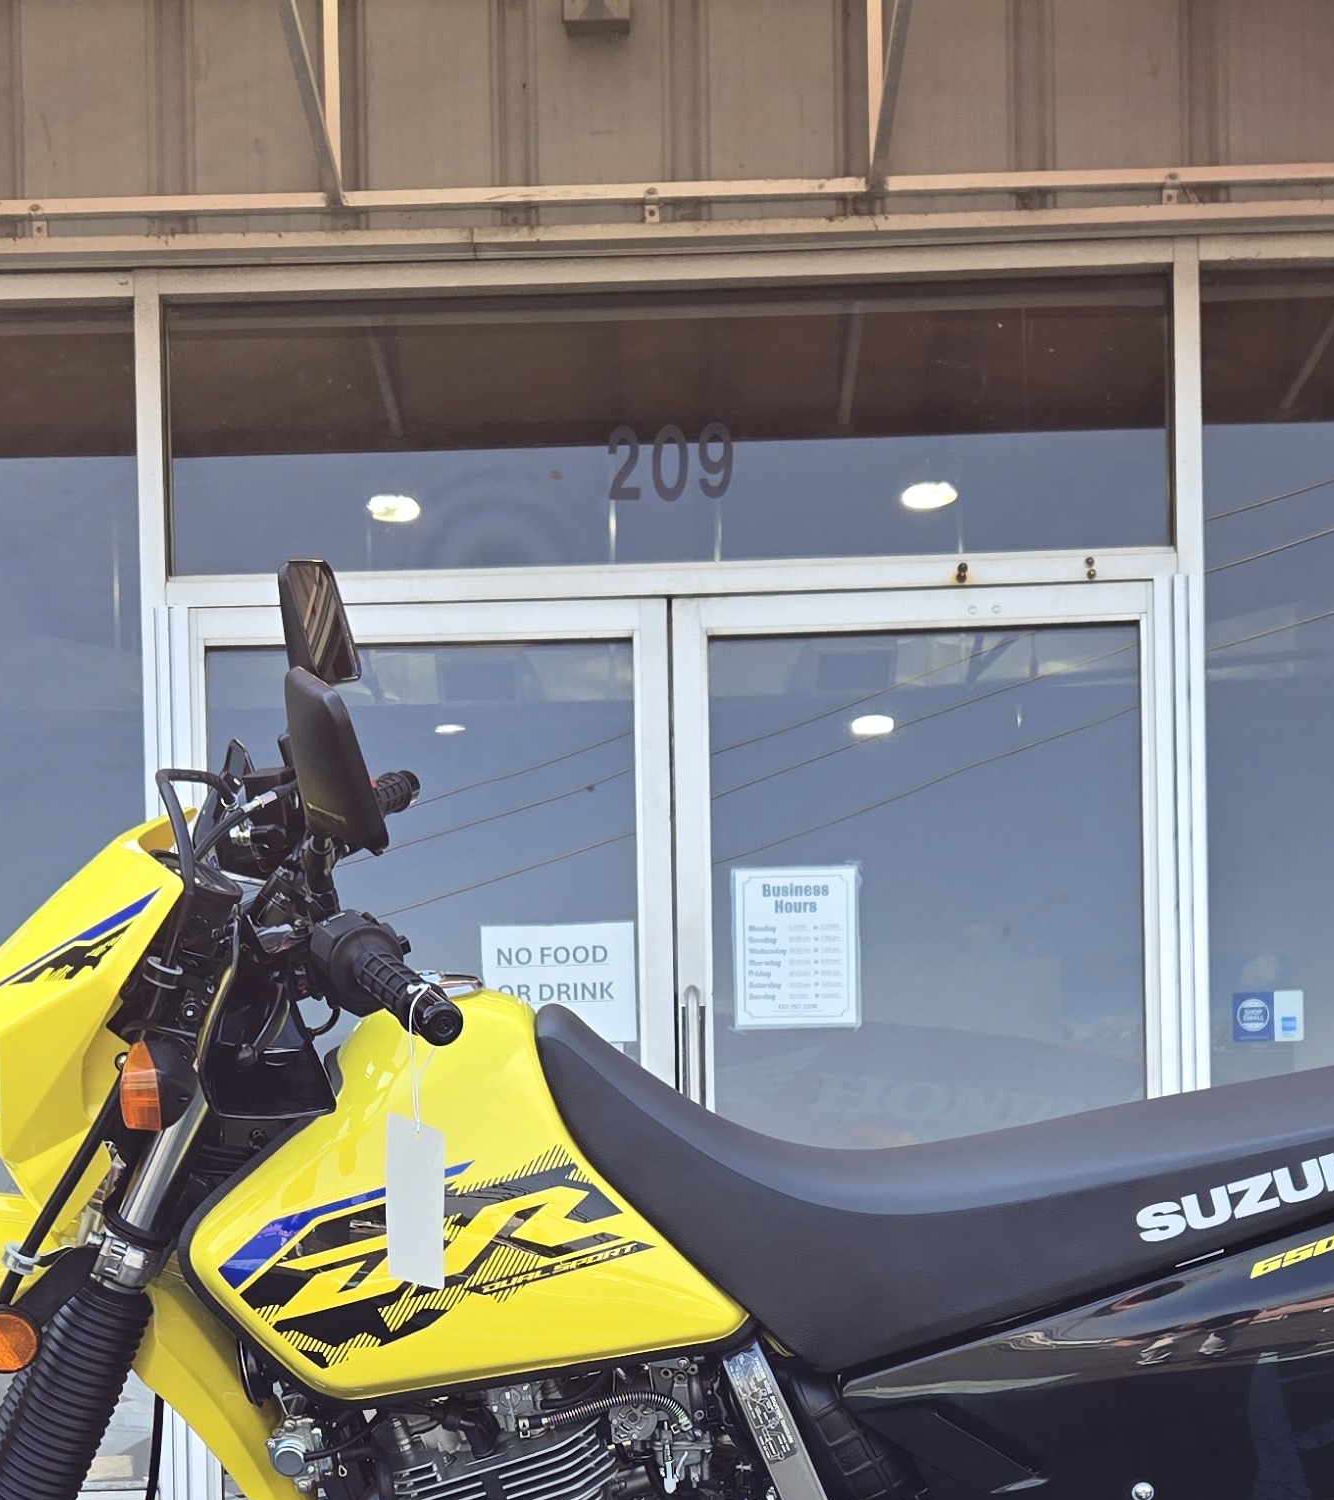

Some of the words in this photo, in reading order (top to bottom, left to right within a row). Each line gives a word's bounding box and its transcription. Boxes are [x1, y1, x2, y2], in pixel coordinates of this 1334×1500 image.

[608, 422, 734, 502] 209
[762, 883, 829, 897] Business
[774, 900, 817, 914] Hours
[497, 947, 532, 966] NO
[540, 945, 608, 964] FOOD
[539, 981, 614, 1001] DRINK
[482, 1270, 550, 1294] DUAL
[553, 1242, 638, 1273] SPORT
